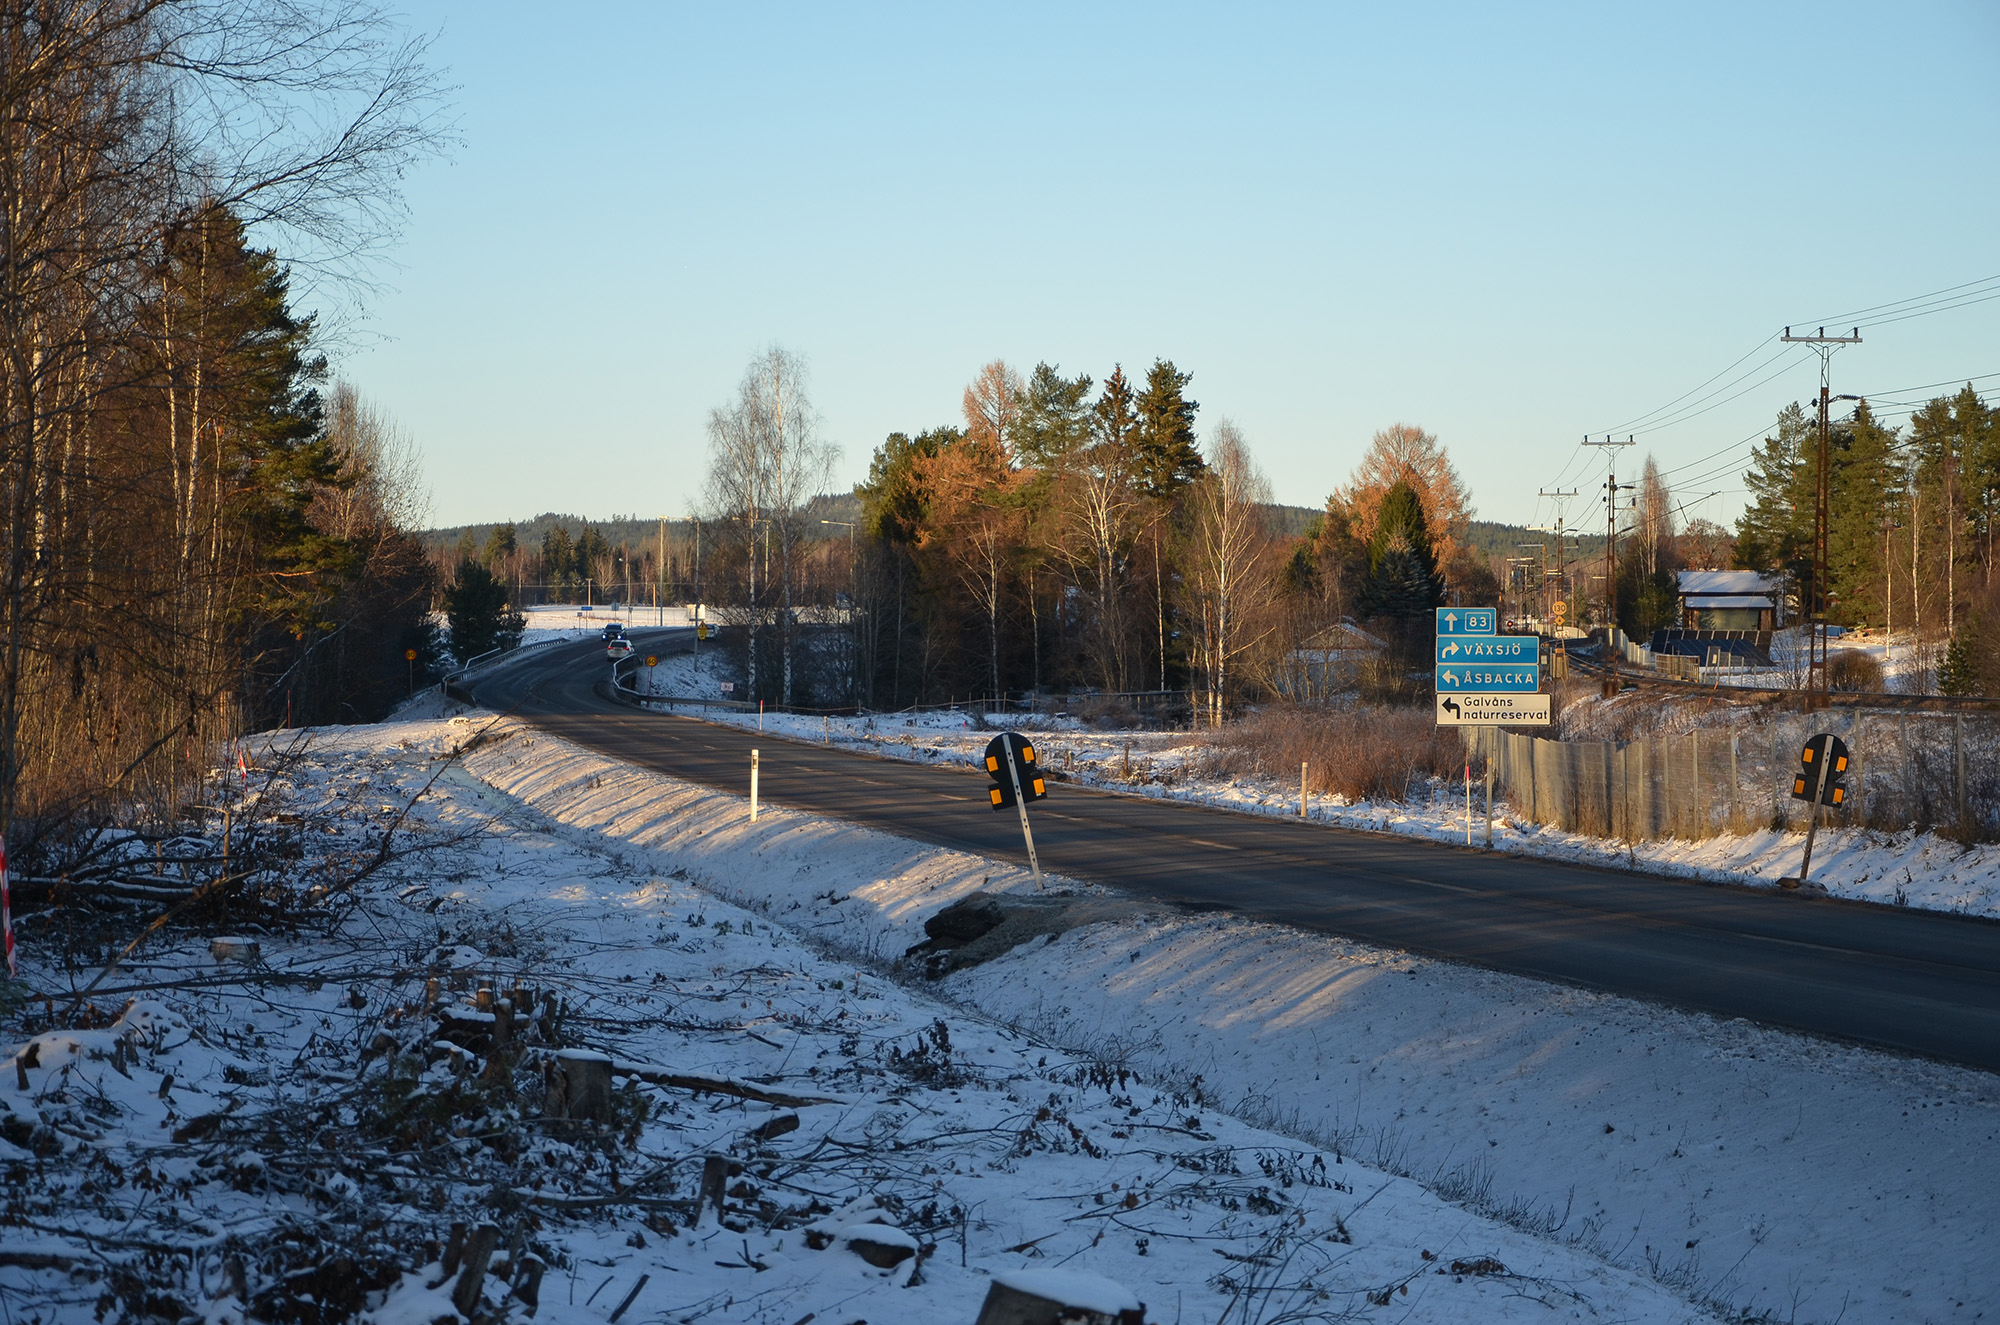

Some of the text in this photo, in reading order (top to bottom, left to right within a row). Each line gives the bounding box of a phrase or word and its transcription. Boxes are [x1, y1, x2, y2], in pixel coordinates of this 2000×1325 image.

[1554, 604, 1566, 612] 130
[1469, 616, 1487, 627] 83
[1464, 642, 1521, 656] VÄXSJÖ
[1464, 670, 1534, 684] ÅSBACKA
[1464, 696, 1513, 707] Galvåns
[1464, 710, 1548, 720] naturreservat
